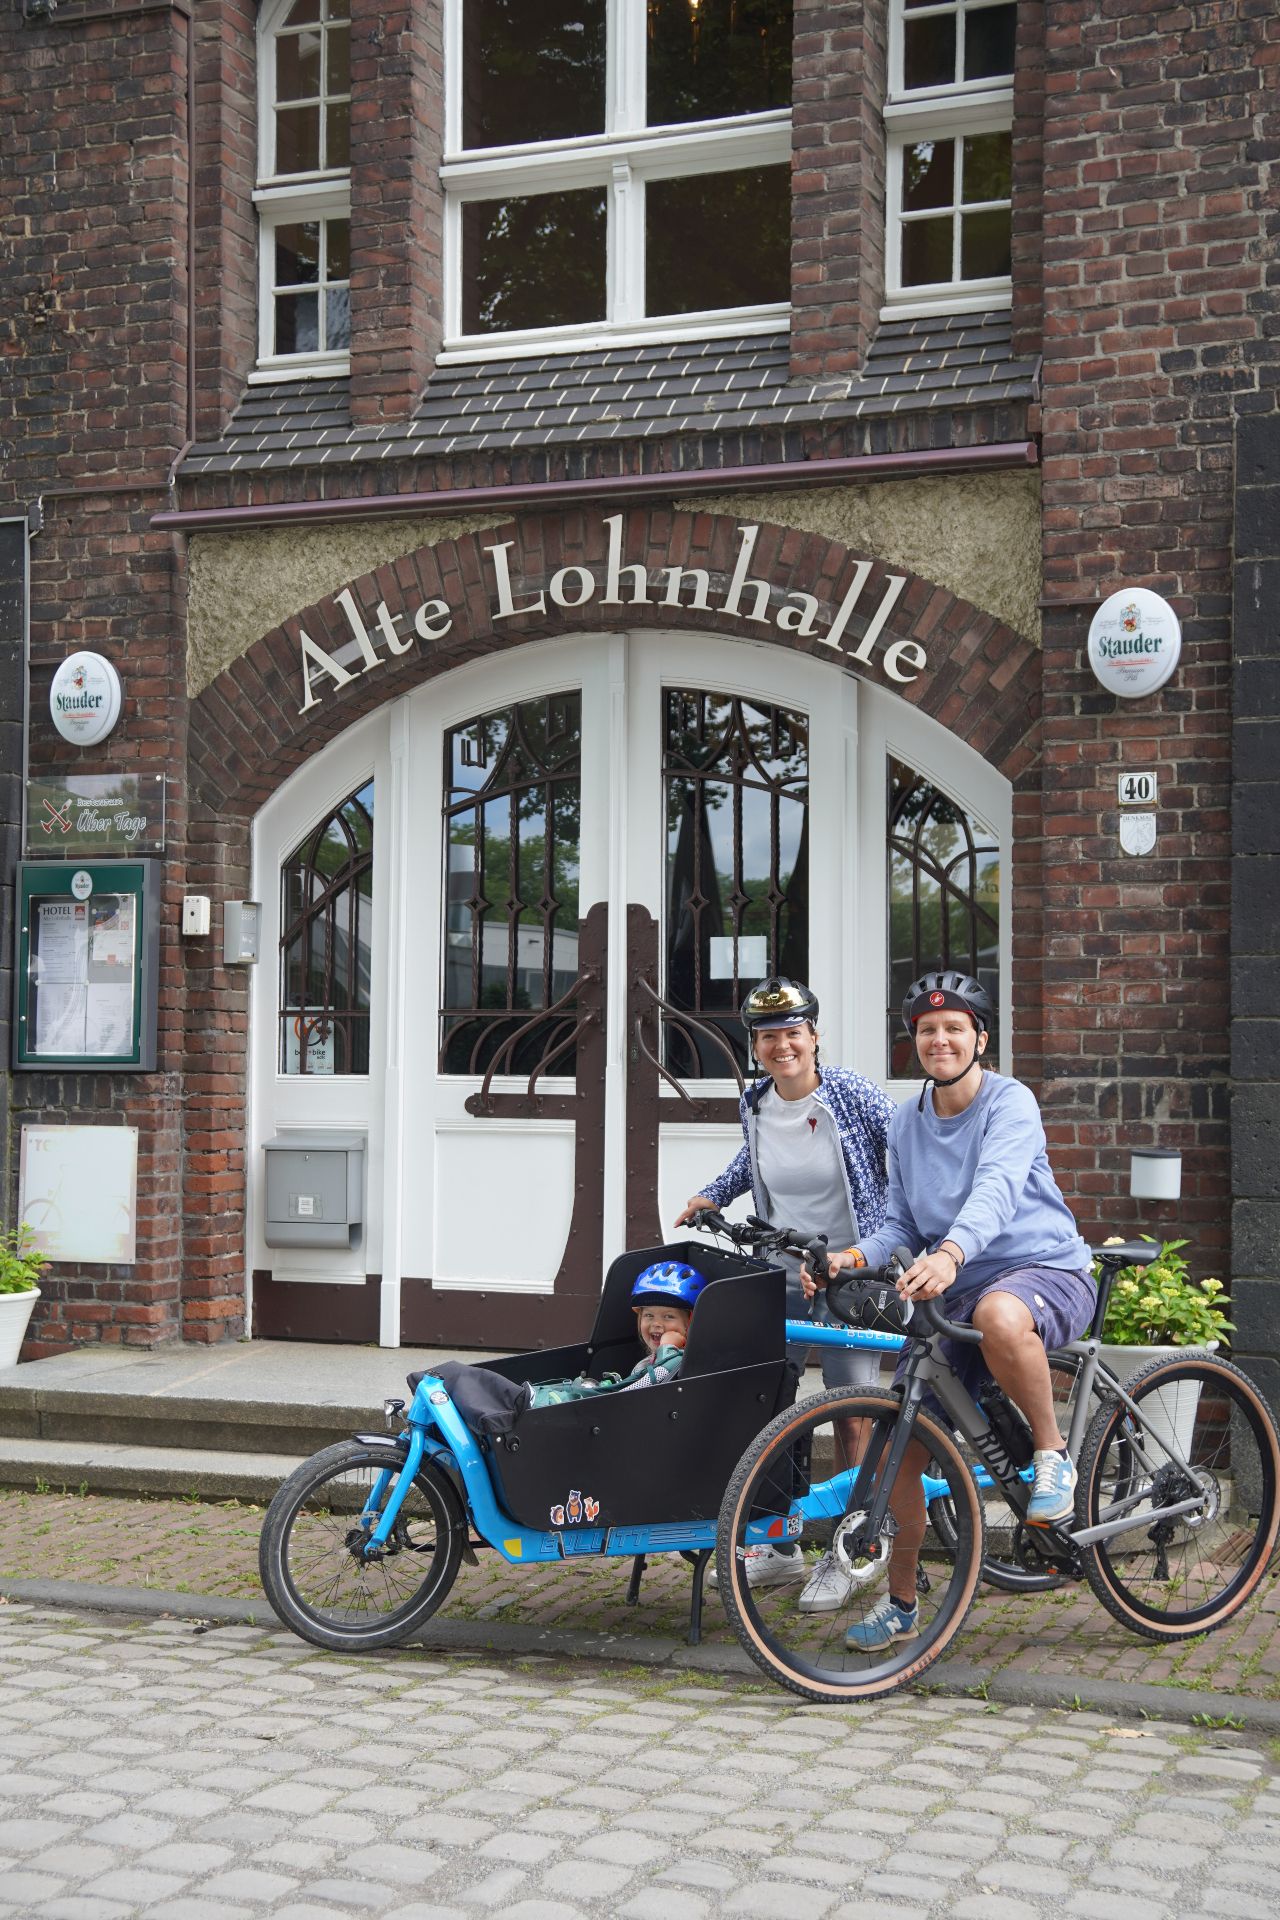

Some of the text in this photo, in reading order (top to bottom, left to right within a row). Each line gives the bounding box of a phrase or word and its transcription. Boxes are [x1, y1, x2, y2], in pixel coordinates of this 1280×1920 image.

[298, 513, 927, 715] Alte Lohnhalle
[1098, 633, 1163, 659] Stauder
[56, 690, 103, 712] Stauder
[1125, 776, 1150, 800] 40
[76, 808, 147, 840] Über Tage
[43, 906, 71, 915] HOTEL
[903, 1400, 916, 1424] ROSE
[973, 1429, 1020, 1491] ROSE
